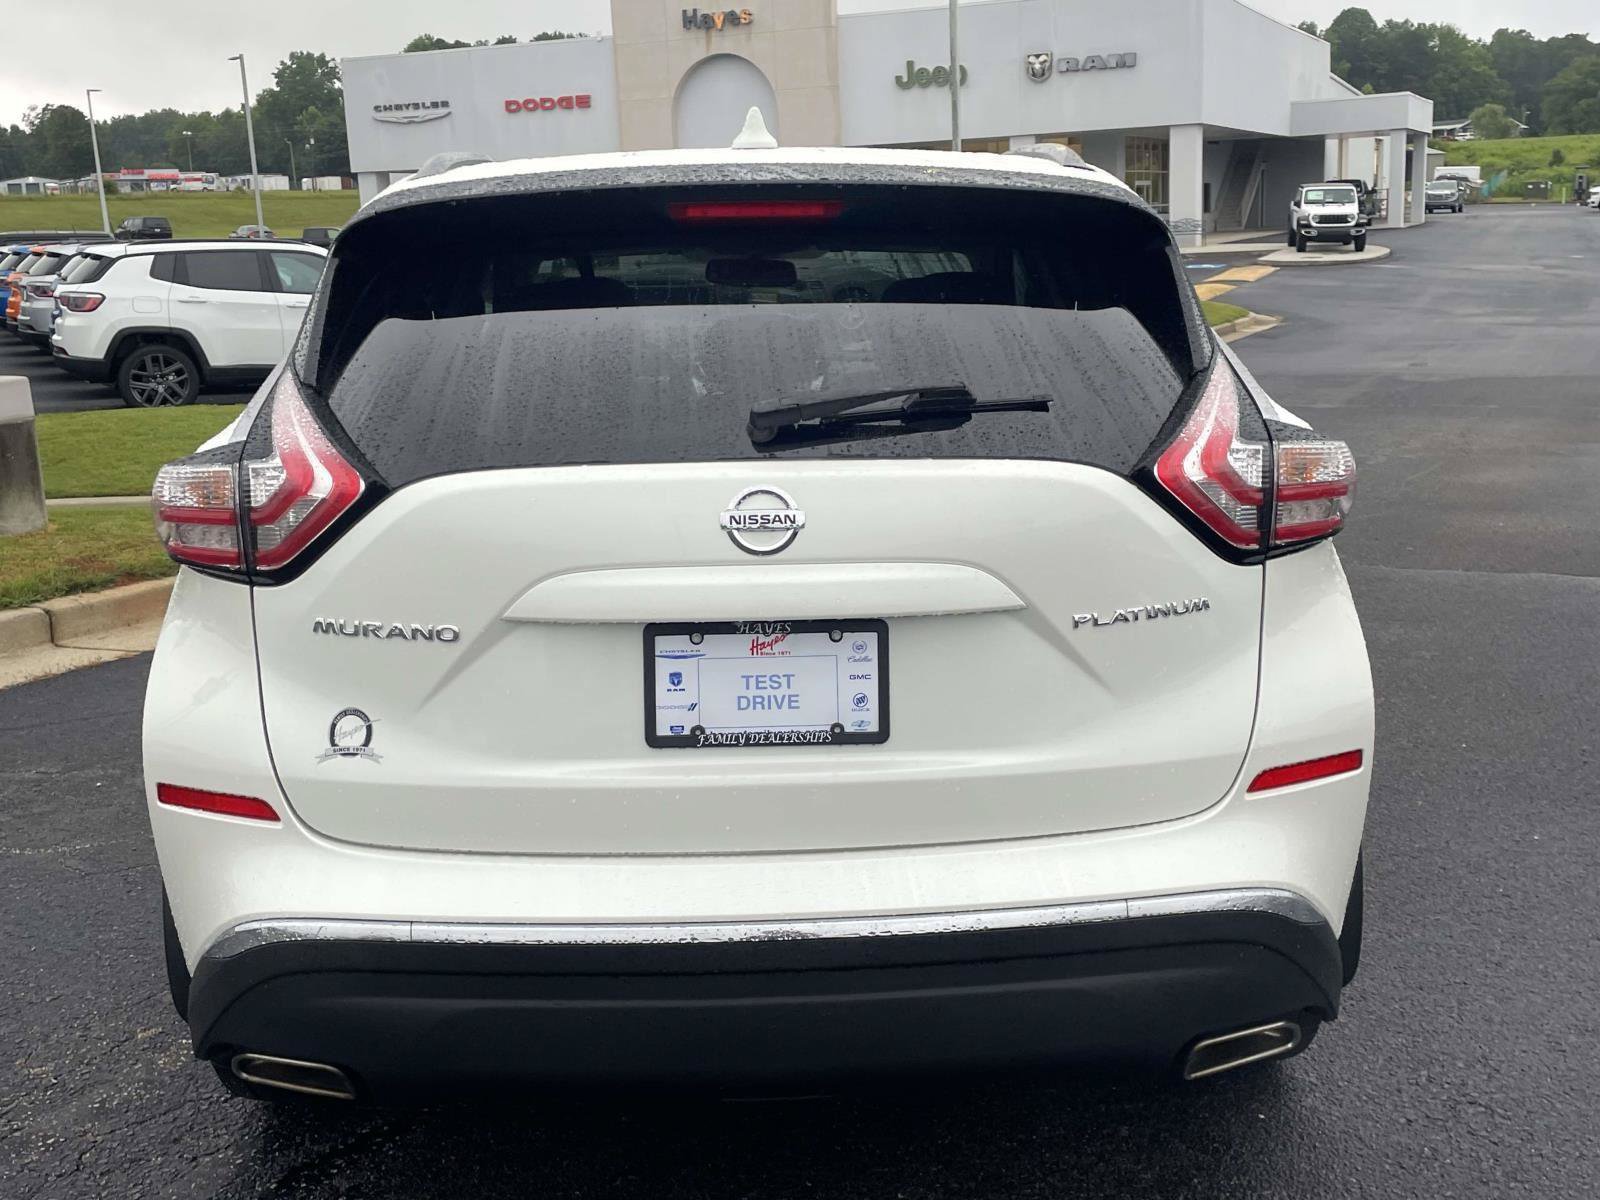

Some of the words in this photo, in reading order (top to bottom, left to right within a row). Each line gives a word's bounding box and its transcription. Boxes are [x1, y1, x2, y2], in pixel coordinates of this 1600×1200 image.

[682, 8, 752, 31] Hayes
[1058, 52, 1137, 73] RAM
[373, 100, 450, 113] CHRYSLER
[504, 95, 591, 114] DODGE
[729, 514, 796, 526] NISSAN
[1072, 597, 1210, 629] PLATINUM
[313, 617, 460, 643] MURANO
[736, 622, 792, 636] HAYES
[741, 674, 795, 690] TEST
[737, 694, 800, 711] DRIVE
[697, 733, 746, 747] FAMILY
[749, 731, 832, 744] DEALERSHIPS
